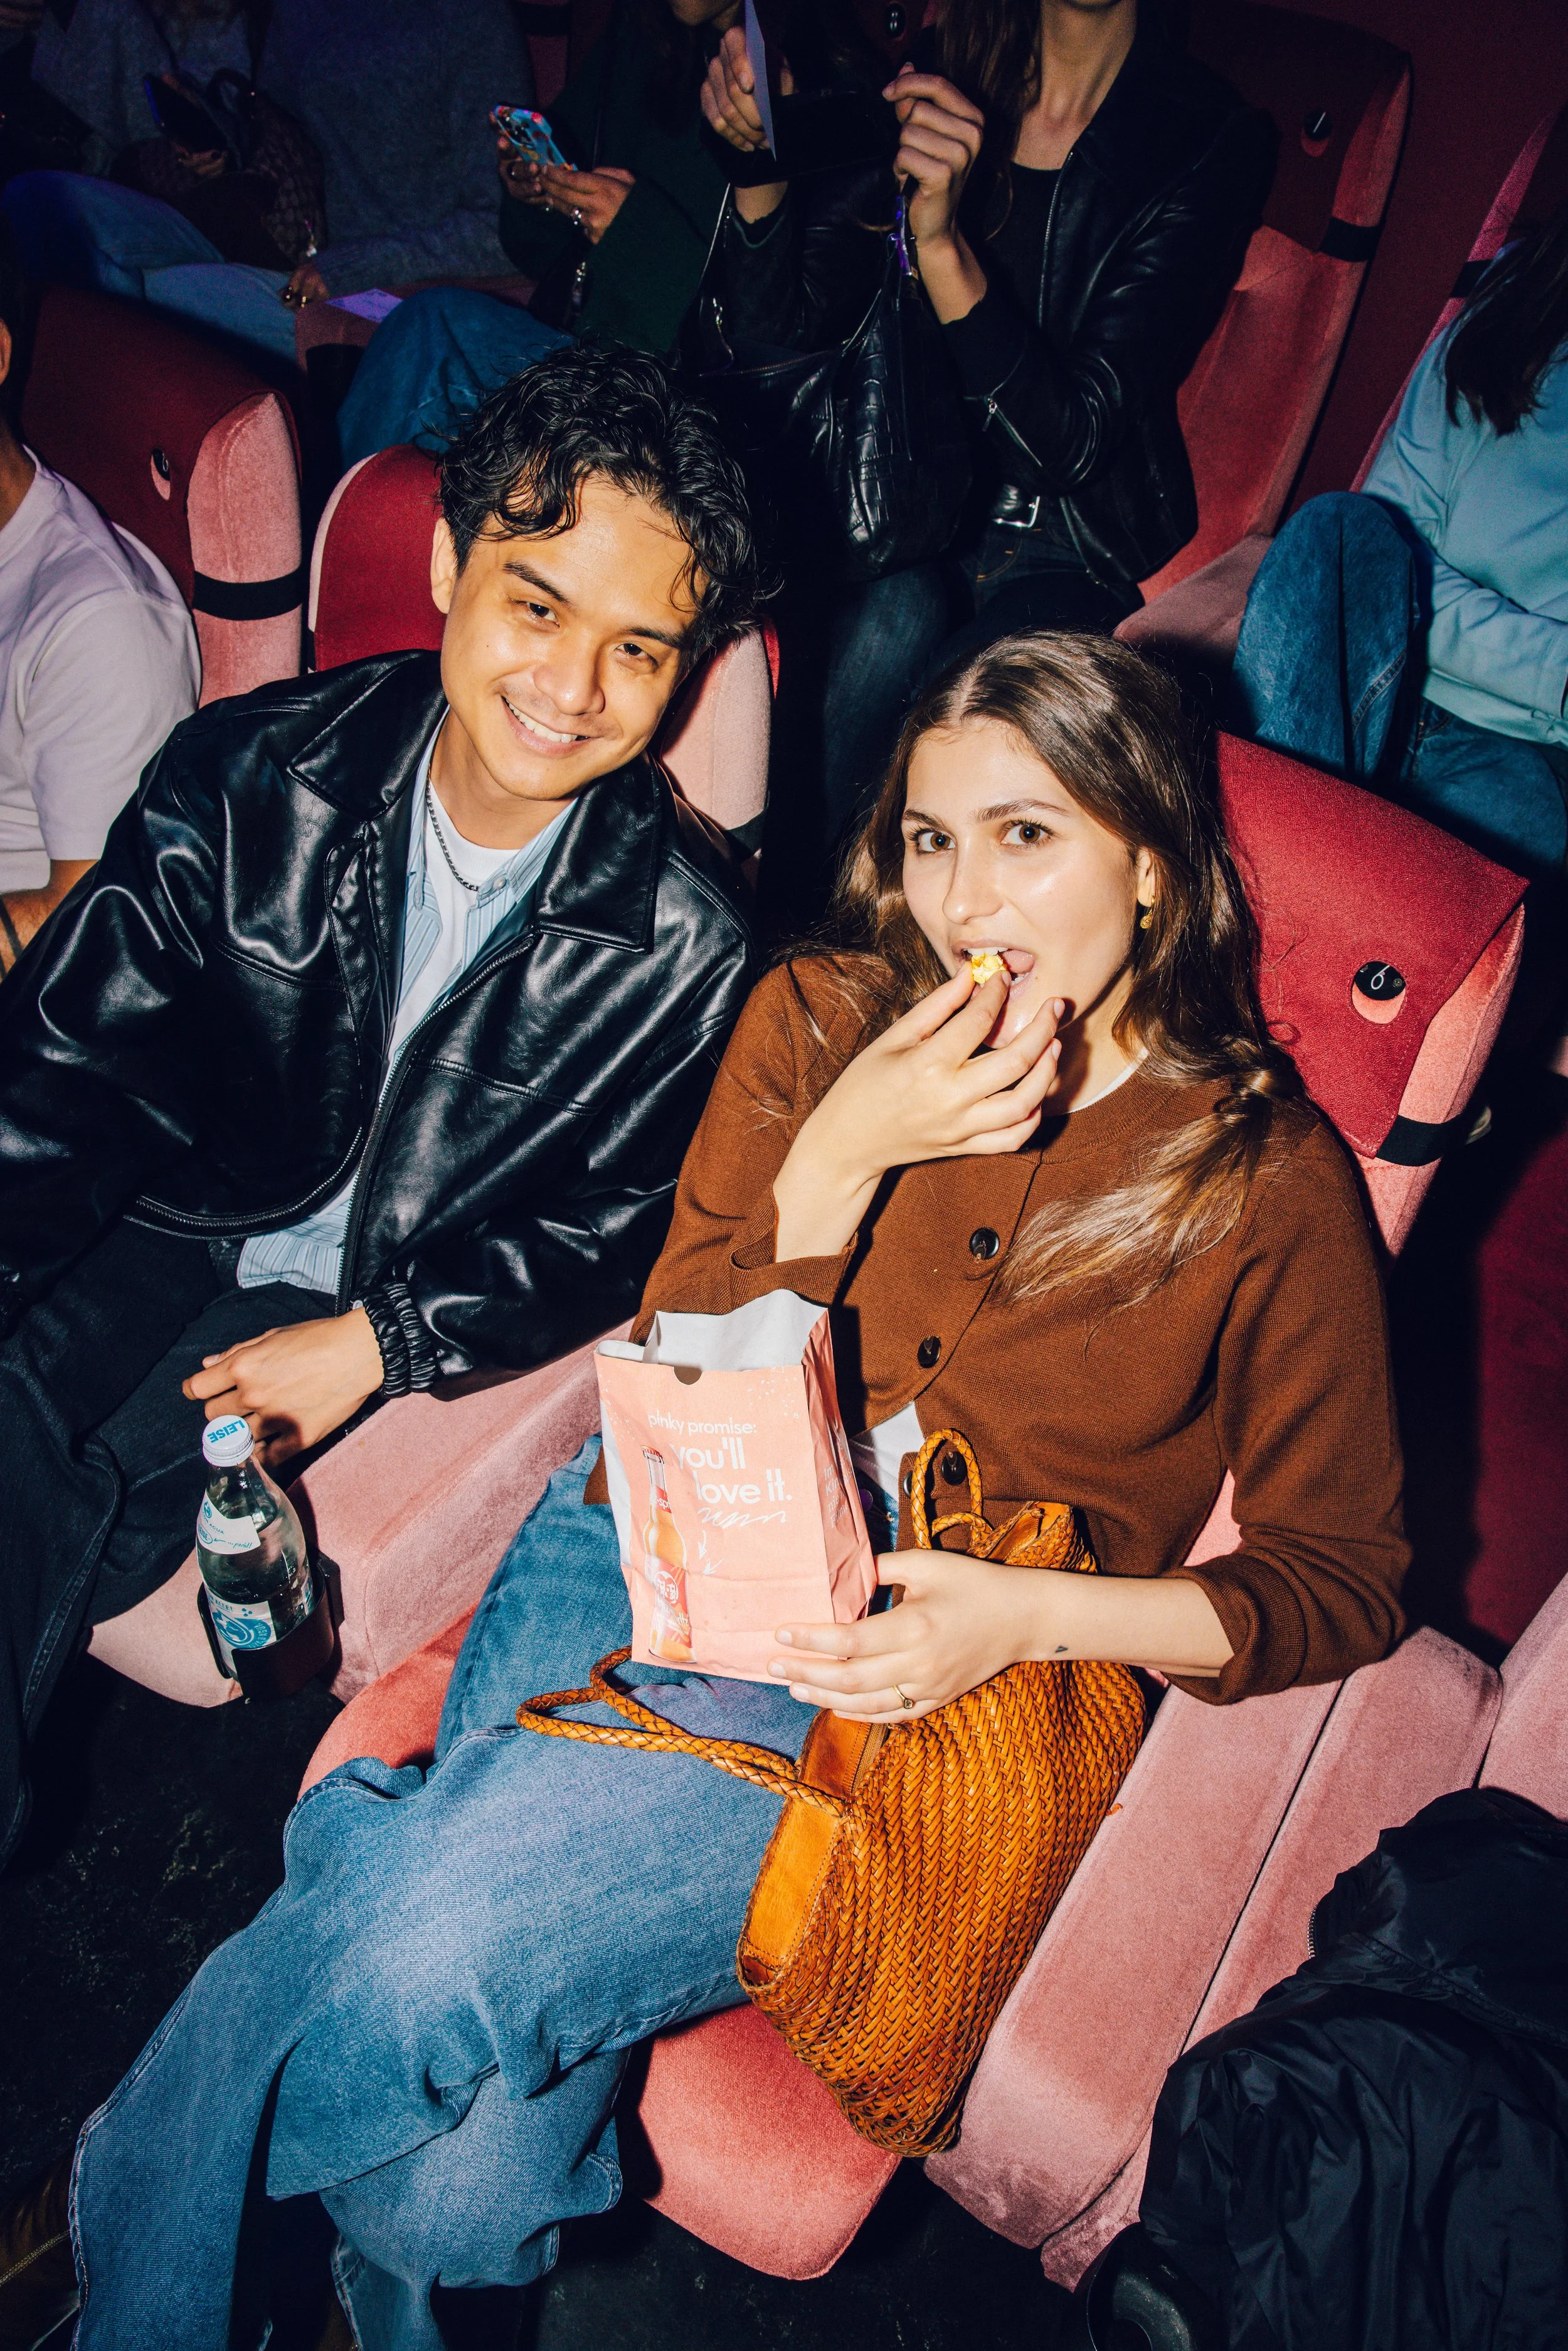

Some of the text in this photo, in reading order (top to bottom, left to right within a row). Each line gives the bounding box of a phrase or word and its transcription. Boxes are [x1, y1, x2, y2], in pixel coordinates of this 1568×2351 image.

[1371, 965, 1390, 990] 6
[207, 1420, 245, 1443] LEISE
[648, 1409, 757, 1436] pinky promise:
[669, 1437, 746, 1470] you'll
[692, 1468, 792, 1504] love it.
